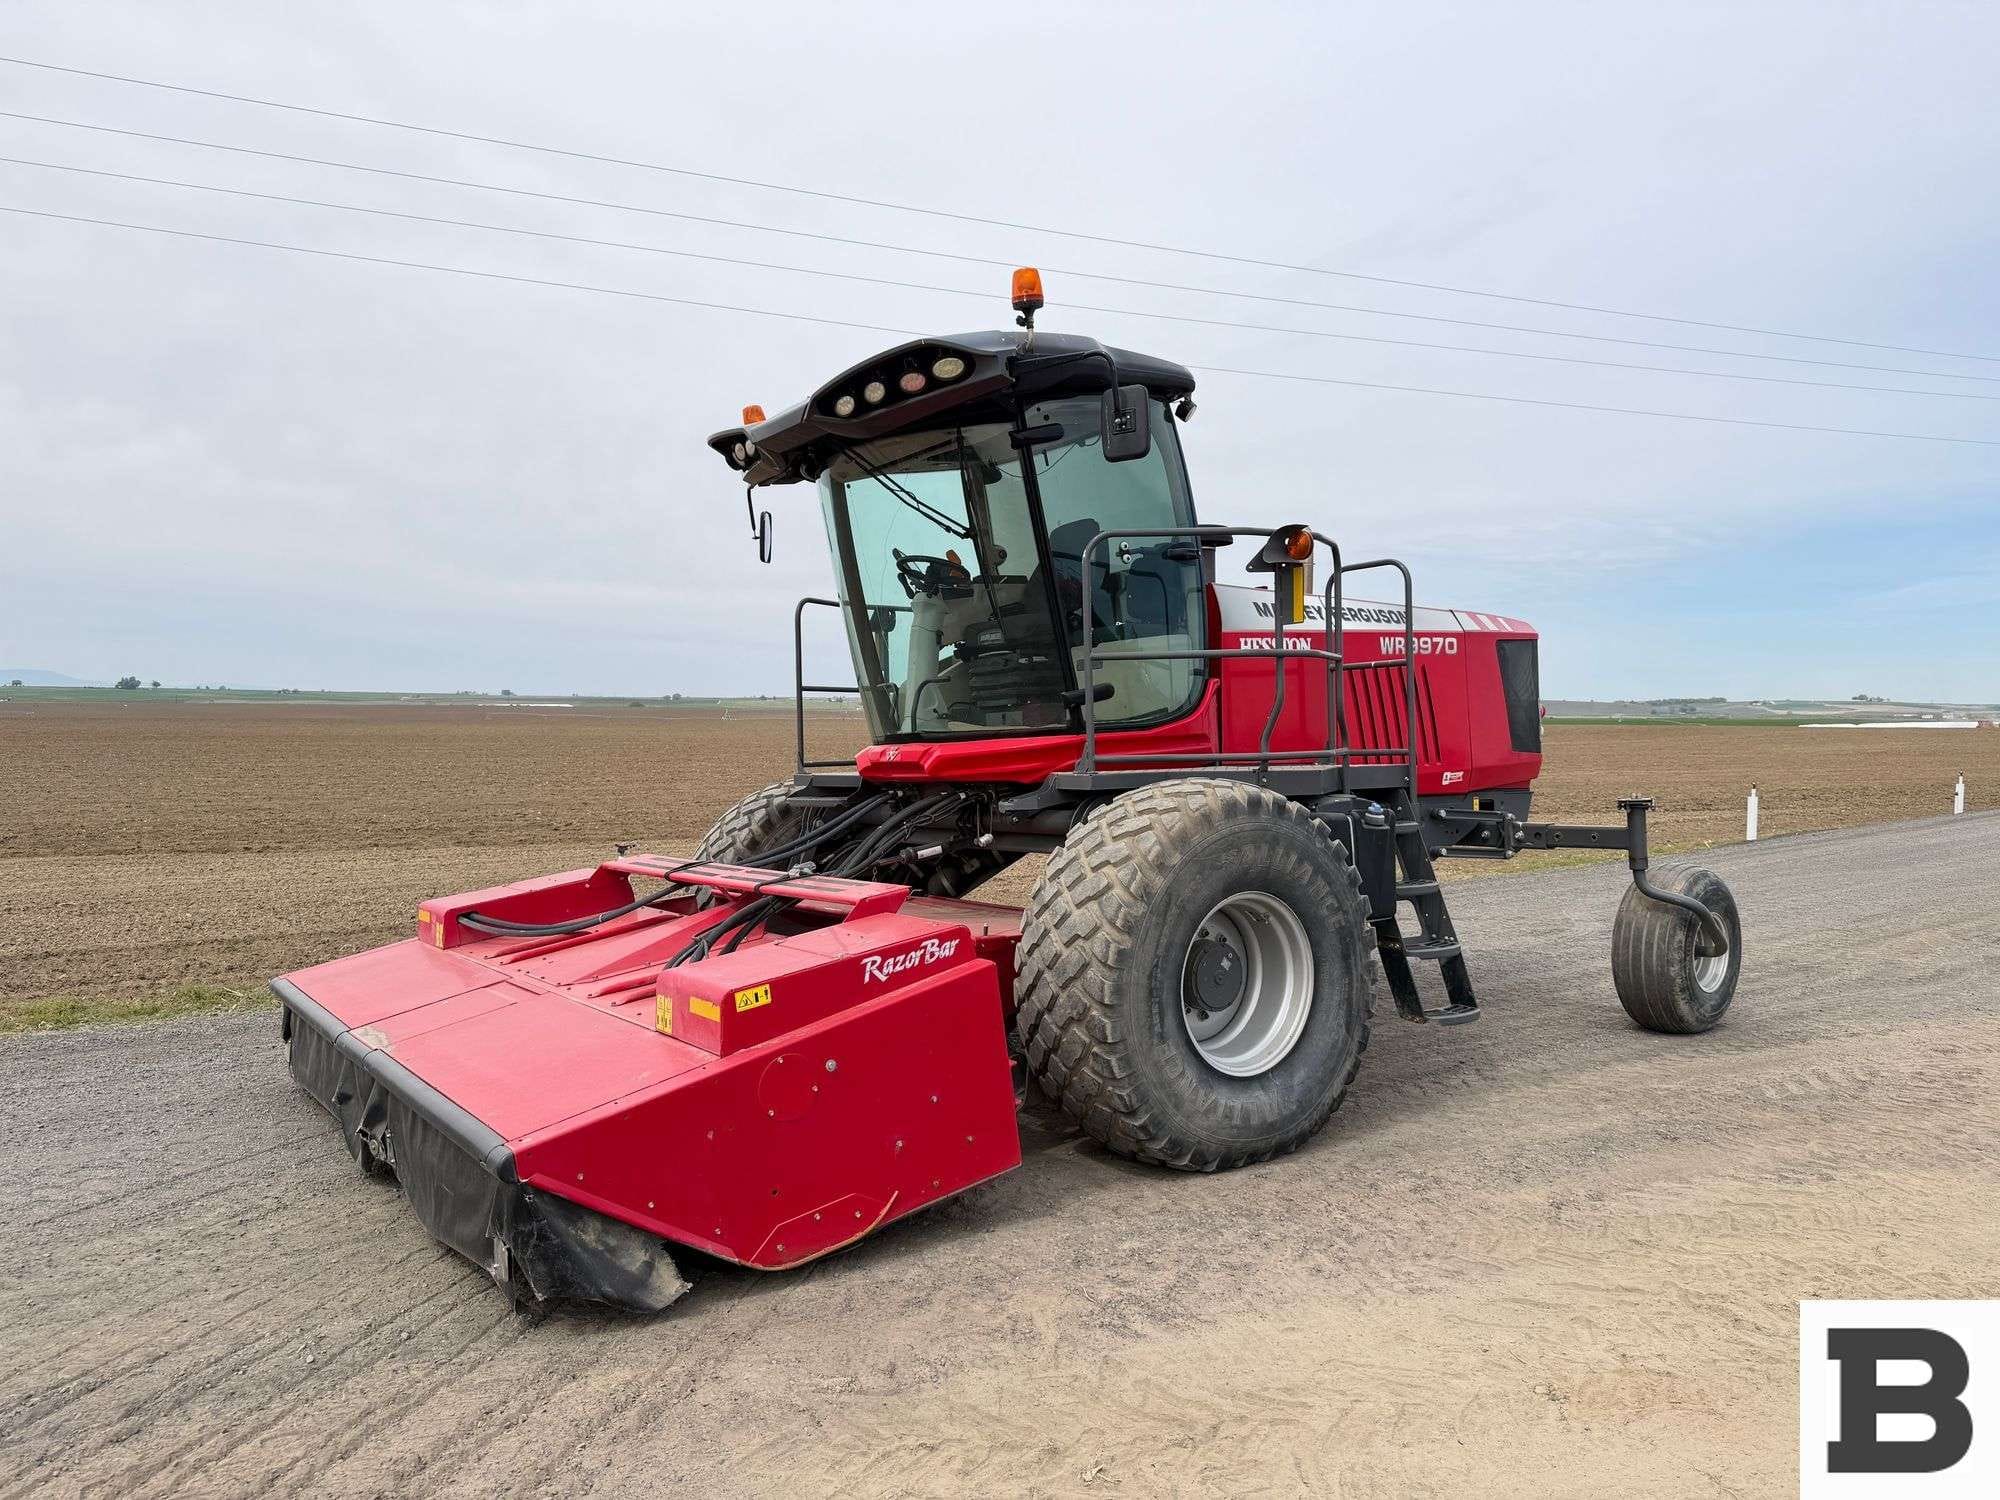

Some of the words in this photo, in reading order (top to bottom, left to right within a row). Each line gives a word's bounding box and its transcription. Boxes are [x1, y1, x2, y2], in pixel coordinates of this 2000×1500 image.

[1252, 602, 1324, 620] MEY
[1327, 607, 1407, 624] ERGUSON
[861, 938, 960, 984] RazorBar
